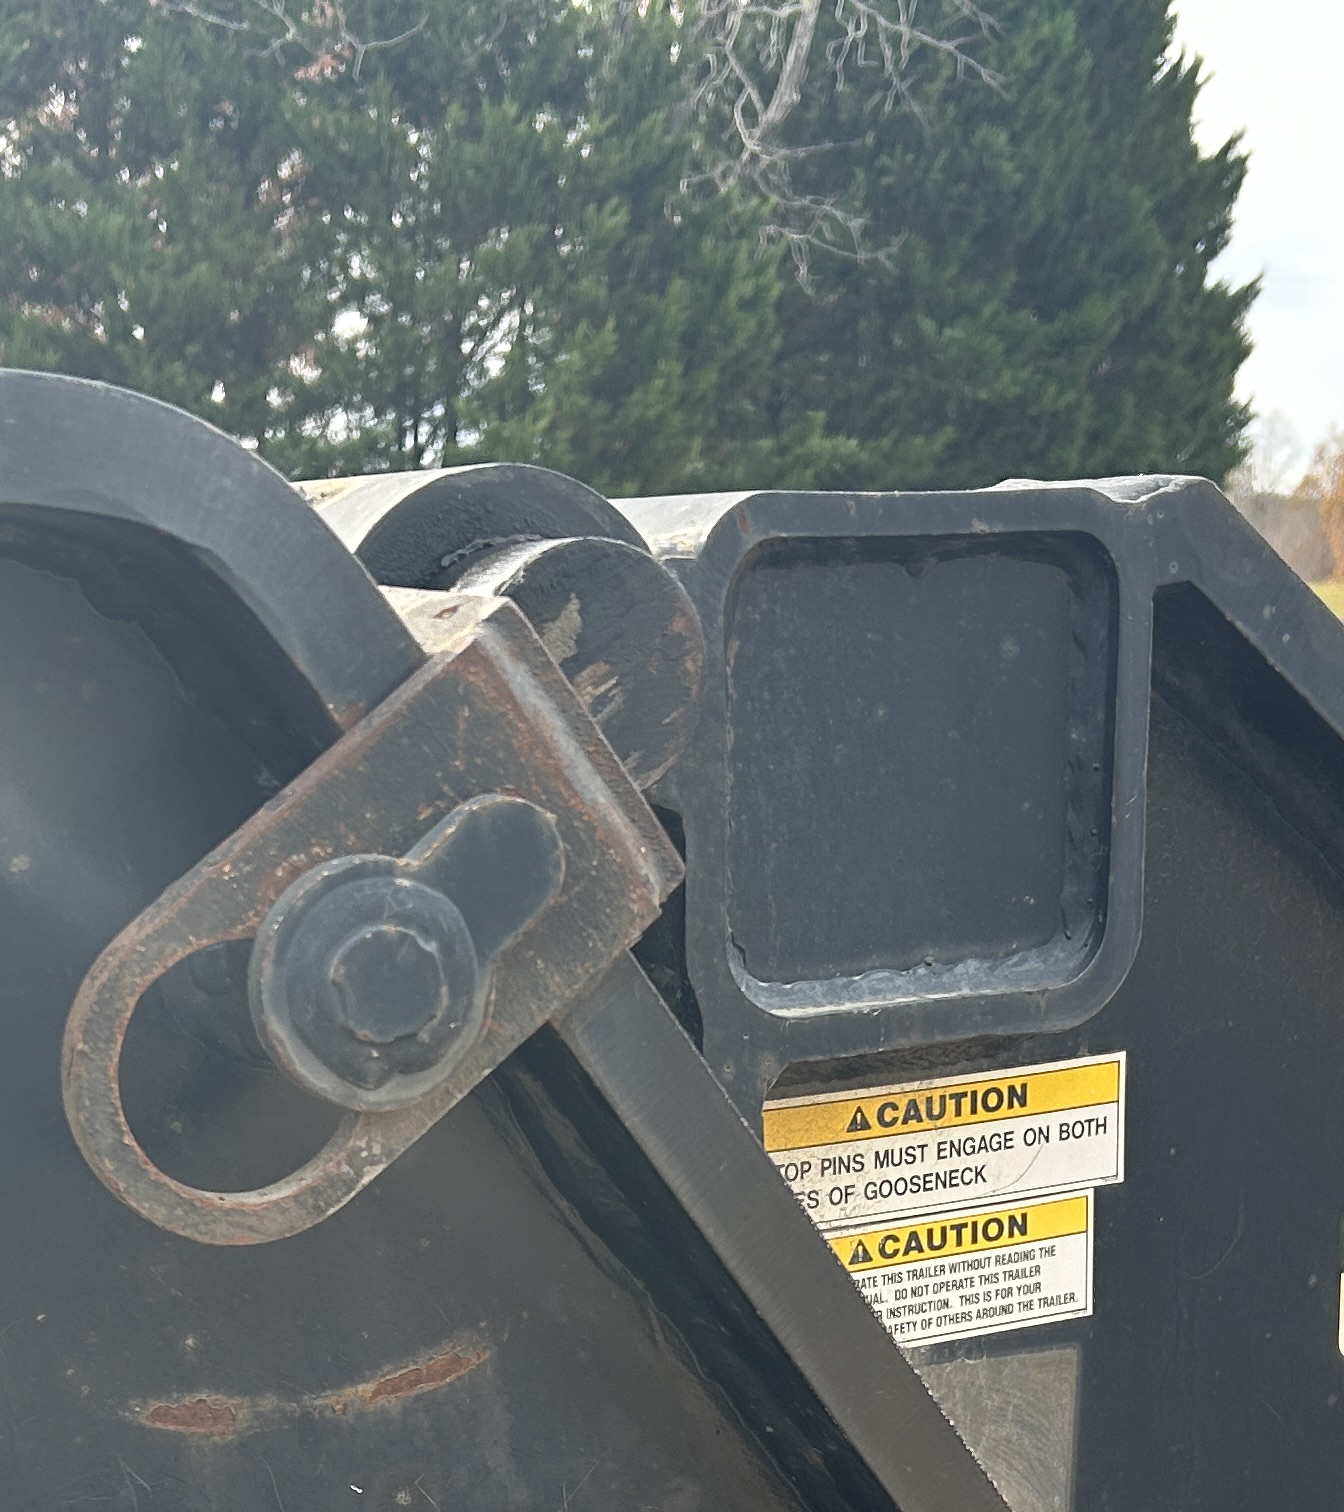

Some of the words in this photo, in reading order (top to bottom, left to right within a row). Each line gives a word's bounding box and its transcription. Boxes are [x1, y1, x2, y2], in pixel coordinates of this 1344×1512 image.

[876, 1083, 1028, 1129] CAUTION
[775, 1161, 812, 1182] OP
[820, 1153, 865, 1177] PINS
[874, 1144, 928, 1169] MUST
[937, 1131, 1015, 1160] ENGAGE
[1023, 1124, 1050, 1147] ON
[1059, 1116, 1108, 1141] BOTH
[829, 1184, 855, 1206] OF
[864, 1164, 987, 1200] GOOSENECK
[878, 1212, 1028, 1259] CAUTION
[881, 1272, 903, 1286] THIS
[906, 1264, 946, 1281] TRAILER
[948, 1256, 992, 1274] WITHOUT
[995, 1248, 1035, 1267] READING
[1038, 1244, 1056, 1259] THE
[894, 1288, 907, 1301] DO
[910, 1284, 930, 1298] NOT
[932, 1276, 976, 1294] OPERATE
[978, 1272, 999, 1286] THIS
[1002, 1264, 1041, 1280] TRAILER
[886, 1298, 952, 1319] INSTRUCTION.
[959, 1292, 980, 1307] THIS
[983, 1290, 992, 1302] IS
[995, 1287, 1013, 1300] FOR
[1016, 1282, 1042, 1296] YOUR
[887, 1320, 917, 1335] AFETY
[921, 1317, 933, 1330] OF
[936, 1311, 973, 1327] OTHERS
[976, 1303, 1014, 1320] AROUND
[1017, 1299, 1034, 1313] THE
[1037, 1292, 1078, 1309] TRAILER.
